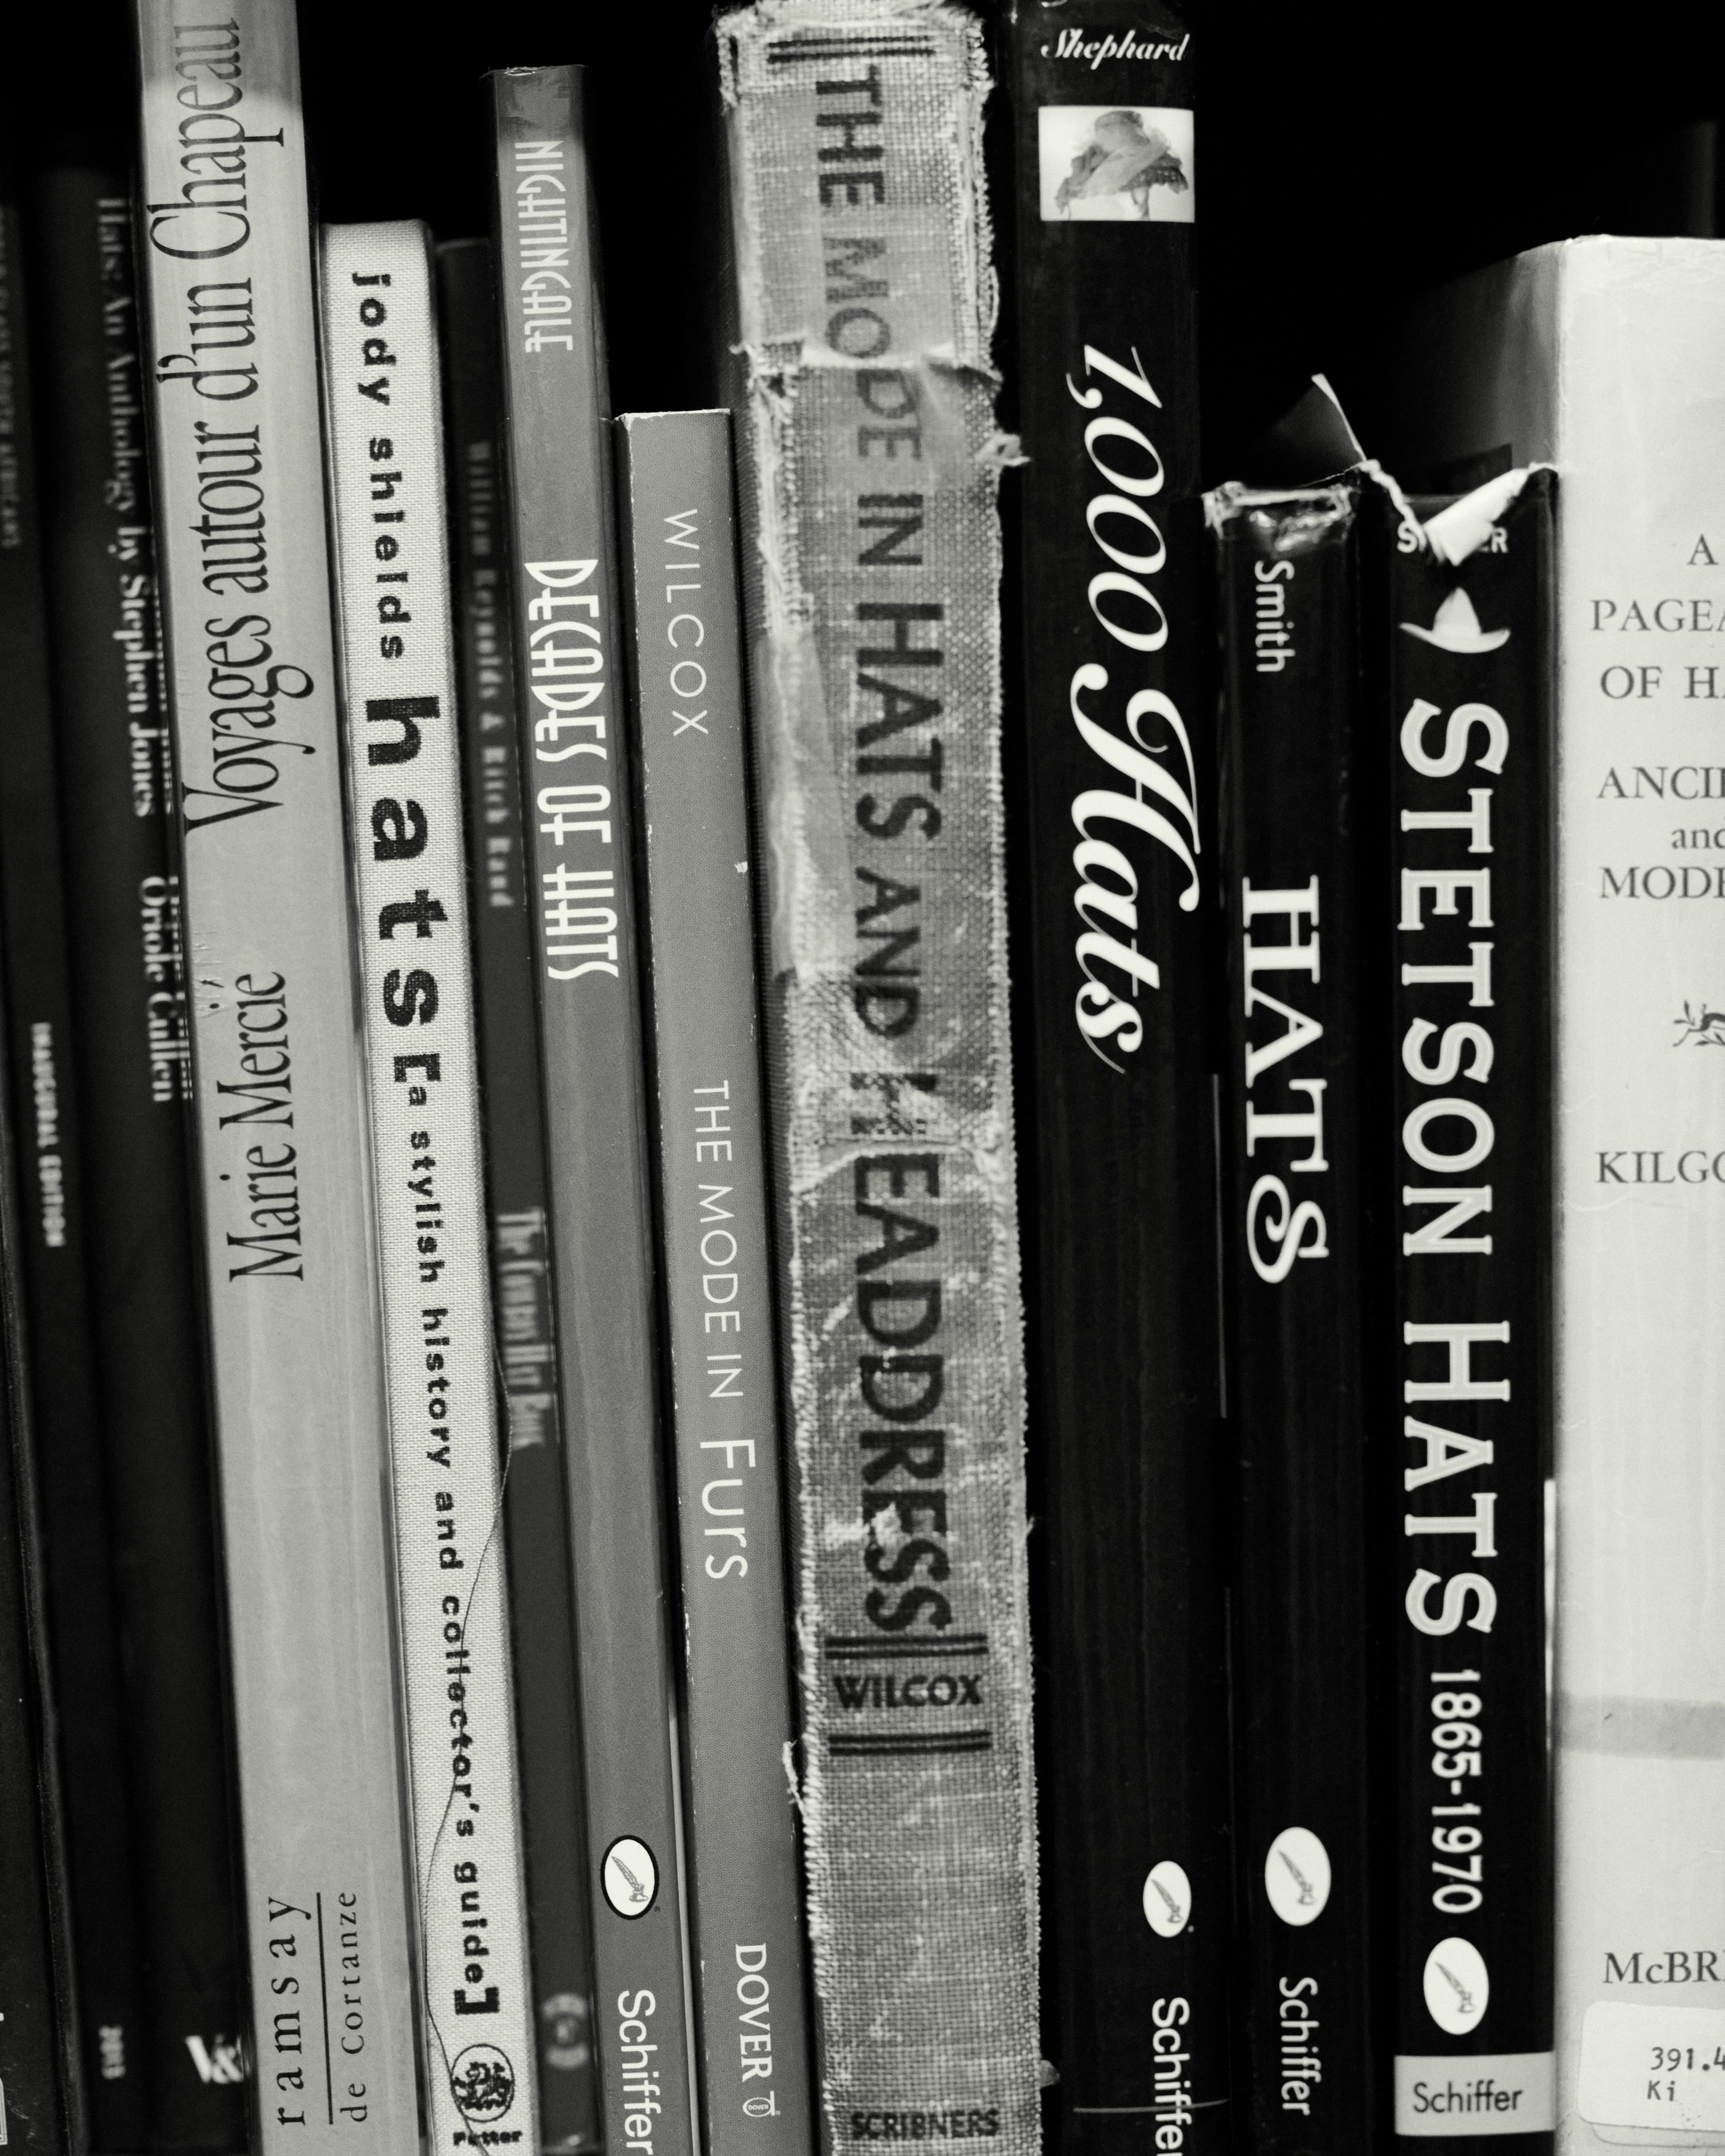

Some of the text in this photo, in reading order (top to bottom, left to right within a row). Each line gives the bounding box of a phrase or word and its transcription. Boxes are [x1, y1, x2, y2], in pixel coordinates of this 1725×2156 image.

[1040, 28, 1190, 70] Shephard
[146, 18, 284, 260] Chapeau
[816, 64, 885, 207] THE
[514, 140, 574, 353] NIGHTINGALE
[822, 237, 922, 460] MODE
[189, 420, 269, 595] autour
[352, 272, 411, 661] jody shields
[858, 494, 924, 565] IN
[663, 508, 709, 737] WILCOX
[1254, 561, 1296, 672] Smith
[1590, 599, 1725, 632] PAGE
[1687, 534, 1718, 566] A
[112, 574, 156, 713] Stephen
[856, 603, 944, 840] HATS
[1066, 345, 1201, 1074] 1,000 Hats
[1600, 666, 1725, 698] OF H
[129, 721, 161, 817] Jones
[181, 614, 316, 837] Voyages
[524, 559, 619, 981] DECADES OF HATS
[364, 696, 448, 1028] hats
[139, 875, 183, 1103] Oriole Cullen
[855, 866, 921, 1038] AND
[200, 971, 304, 1282] Marie Mercié
[694, 1080, 733, 1162] THE
[1242, 875, 1329, 1283] HATS
[407, 1130, 445, 1285] stylish
[1397, 698, 1510, 1635] STETSON HATS
[698, 1184, 740, 1333] MODE
[421, 1307, 451, 1469] history
[707, 1355, 743, 1398] IN
[435, 1490, 464, 1570] and
[442, 1595, 479, 1838] collector's
[833, 1674, 983, 1707] WILCOX
[1431, 1669, 1482, 1913] 1865-1970
[268, 1896, 312, 2126] ramsay
[338, 1892, 367, 2122] de Cortanze
[735, 1943, 773, 2082] DOVER
[1279, 1977, 1321, 2115] Schiffer
[1603, 1950, 1725, 1984] McBR
[617, 1989, 661, 2155] Schiffer
[851, 2108, 1000, 2140] SCRIBNERS
[1152, 1997, 1192, 2156] Schiffe
[1413, 2080, 1522, 2112] Schiffer
[1647, 2080, 1675, 2101] Ki
